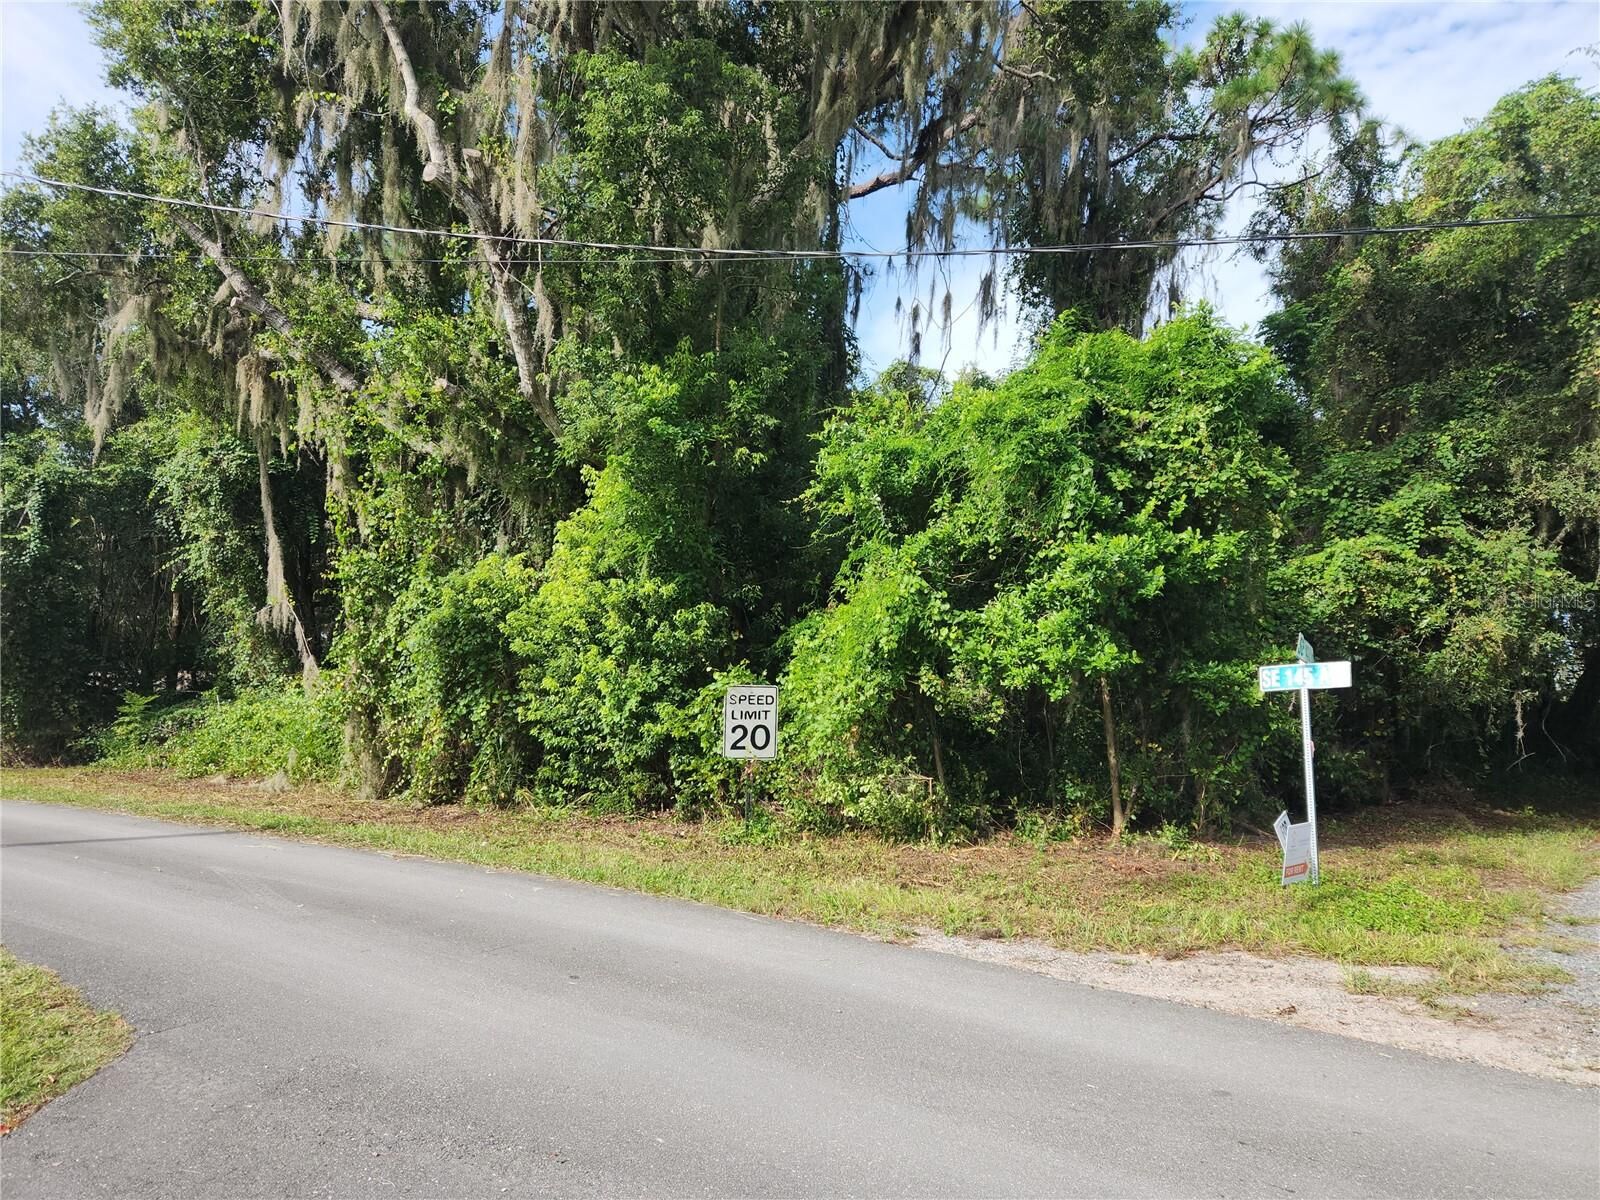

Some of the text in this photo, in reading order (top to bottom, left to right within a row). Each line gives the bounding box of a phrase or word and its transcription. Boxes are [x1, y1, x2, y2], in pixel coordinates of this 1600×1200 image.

[1262, 669, 1281, 688] SE
[1286, 667, 1315, 688] 145
[729, 694, 775, 705] SPEED
[731, 710, 771, 720] LIMIT
[730, 724, 771, 750] 20
